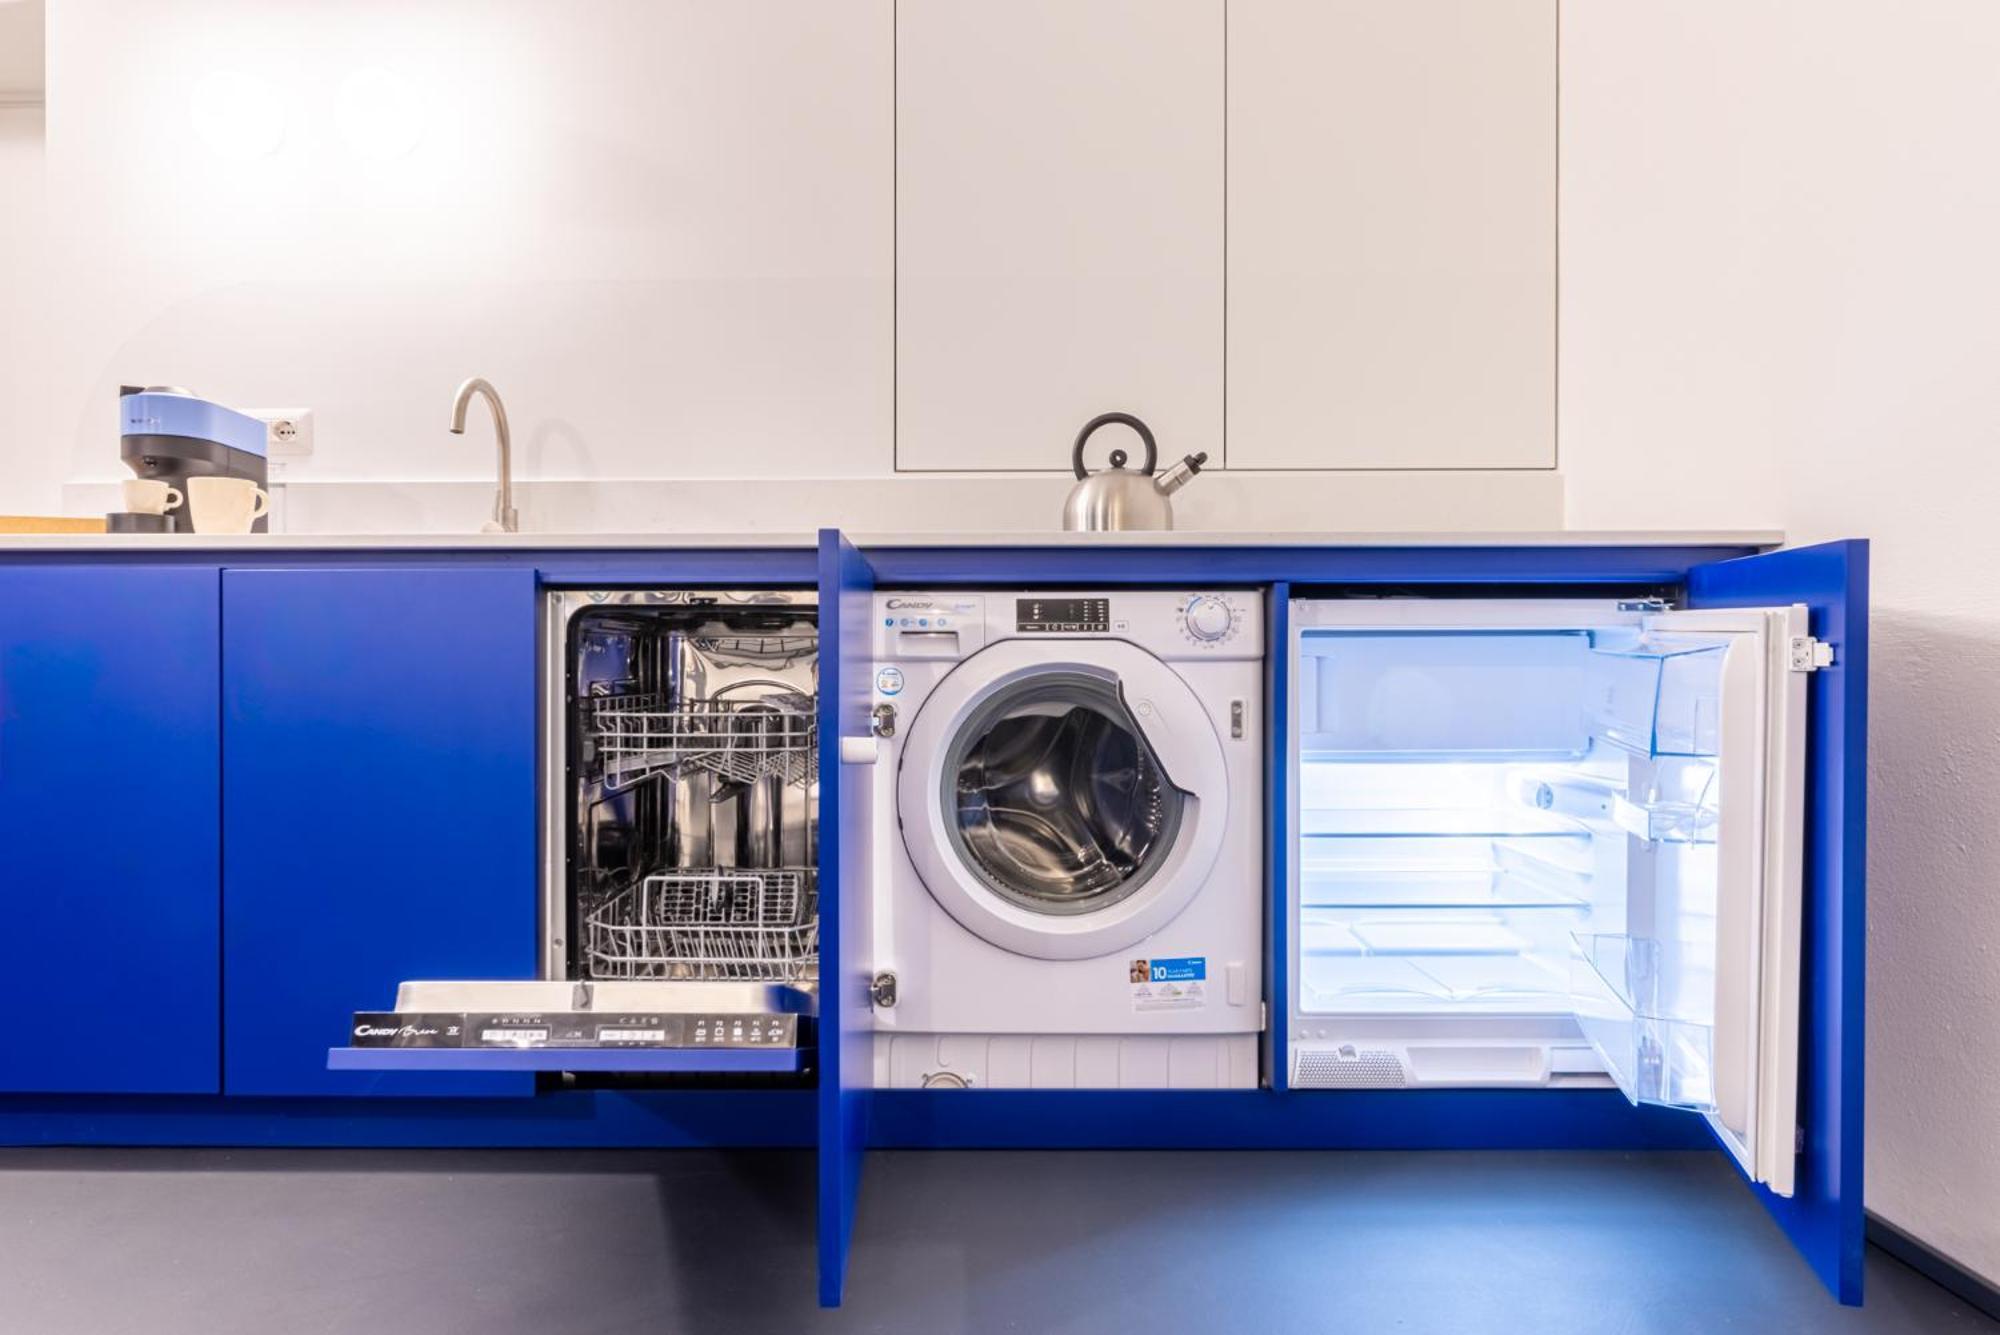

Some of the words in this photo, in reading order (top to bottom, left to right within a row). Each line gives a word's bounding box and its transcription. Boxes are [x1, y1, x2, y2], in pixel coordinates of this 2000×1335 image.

[886, 598, 933, 610] CANDY
[1153, 966, 1167, 979] 10
[354, 1024, 398, 1036] CANDY
